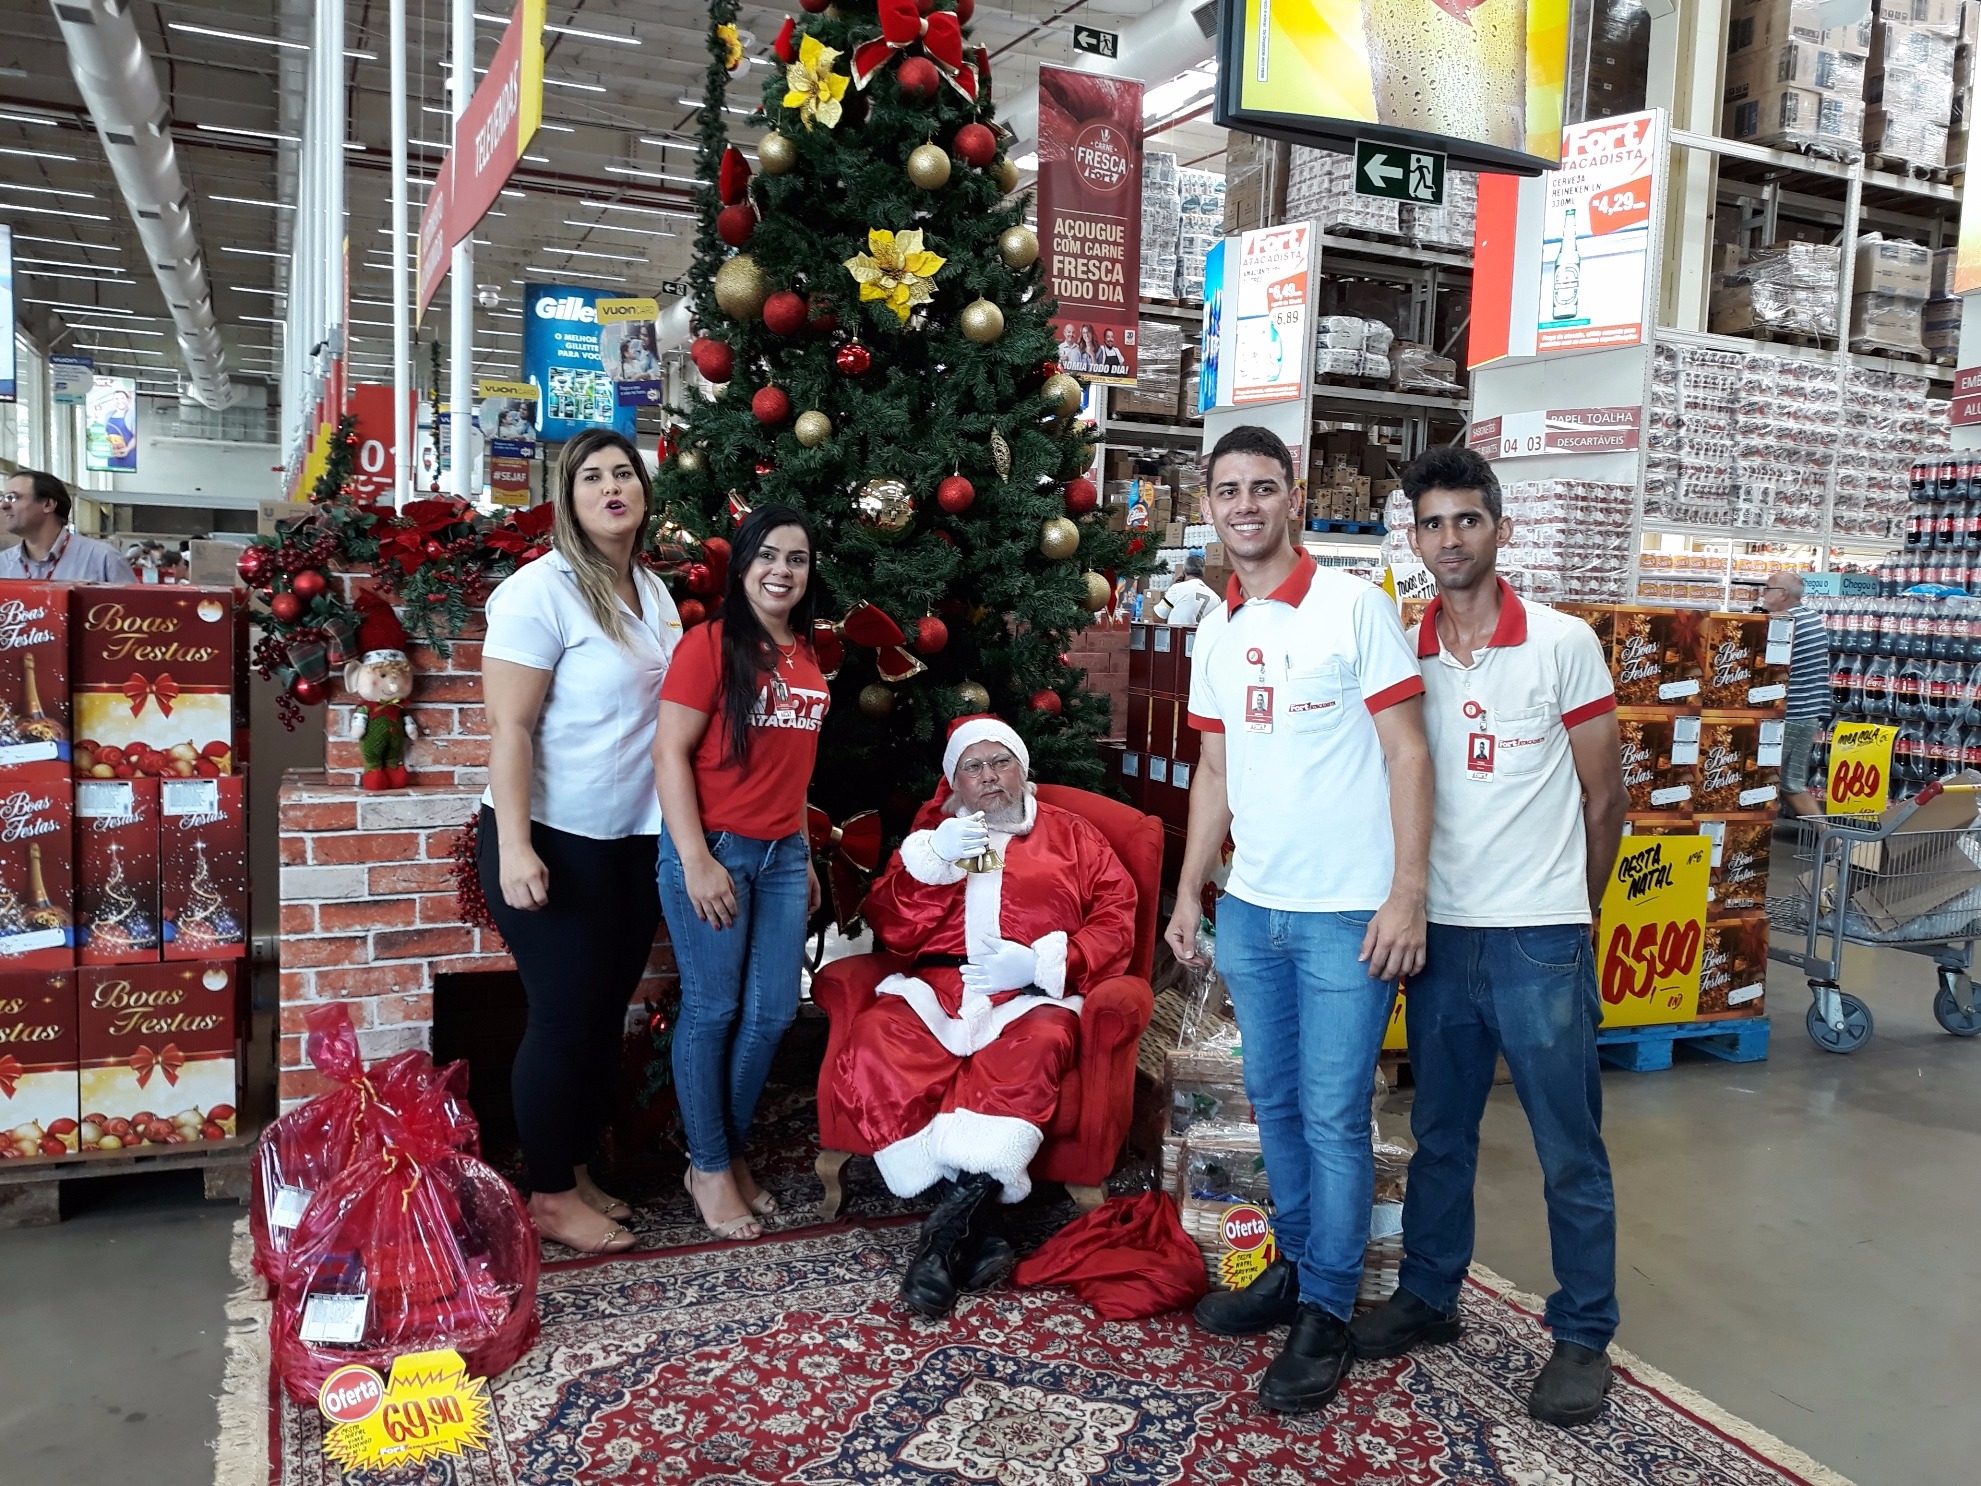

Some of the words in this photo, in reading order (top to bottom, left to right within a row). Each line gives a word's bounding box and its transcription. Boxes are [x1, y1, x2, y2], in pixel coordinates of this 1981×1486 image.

[1094, 141, 1114, 153] CARNE
[1077, 146, 1126, 175] FRESCA
[1552, 148, 1643, 172] TACADISTA
[1552, 174, 1586, 188] CERVEJA
[1552, 197, 1575, 208] 330ML
[1053, 217, 1125, 243] AÇOUGUE
[1053, 237, 1081, 254] COM
[1084, 241, 1125, 260] CARNE
[1243, 250, 1302, 266] ATACADISTA
[1052, 254, 1125, 284] FRESCA
[1051, 277, 1093, 299] TODO
[1098, 283, 1125, 303] DIA
[535, 296, 598, 323] Gille
[554, 332, 563, 340] O
[564, 333, 598, 343] MELHOR
[565, 342, 599, 352] GILLETTE
[557, 349, 580, 358] PARA
[1088, 363, 1109, 373] TODO
[1110, 364, 1129, 375] DIA!
[1551, 414, 1584, 424] PAPEL
[1586, 411, 1634, 424] TOALHA
[1503, 438, 1518, 453] 04
[1527, 435, 1542, 451] 03
[1557, 433, 1624, 447] DESCARTÁVEIS
[1397, 574, 1418, 598] TODOS
[1418, 569, 1428, 586] OS
[1843, 577, 1870, 591] Chegou
[0, 600, 47, 625] Boas
[84, 602, 182, 633] Boas
[1195, 591, 1211, 623] 7
[102, 632, 220, 662] Festas
[1621, 636, 1657, 661] Boas
[1714, 641, 1750, 667] Boas
[1498, 739, 1518, 748] Fort
[1704, 745, 1740, 770] Boas
[0, 792, 53, 820] Boas
[1618, 843, 1662, 883] CESTA
[1728, 851, 1755, 870] Boas
[1627, 862, 1674, 900] NATAL
[91, 979, 188, 1010] Boas
[108, 1005, 225, 1037] Festas
[1225, 1219, 1266, 1240] Oferta
[325, 1378, 379, 1414] Oferta
[380, 1445, 407, 1456] Fort
